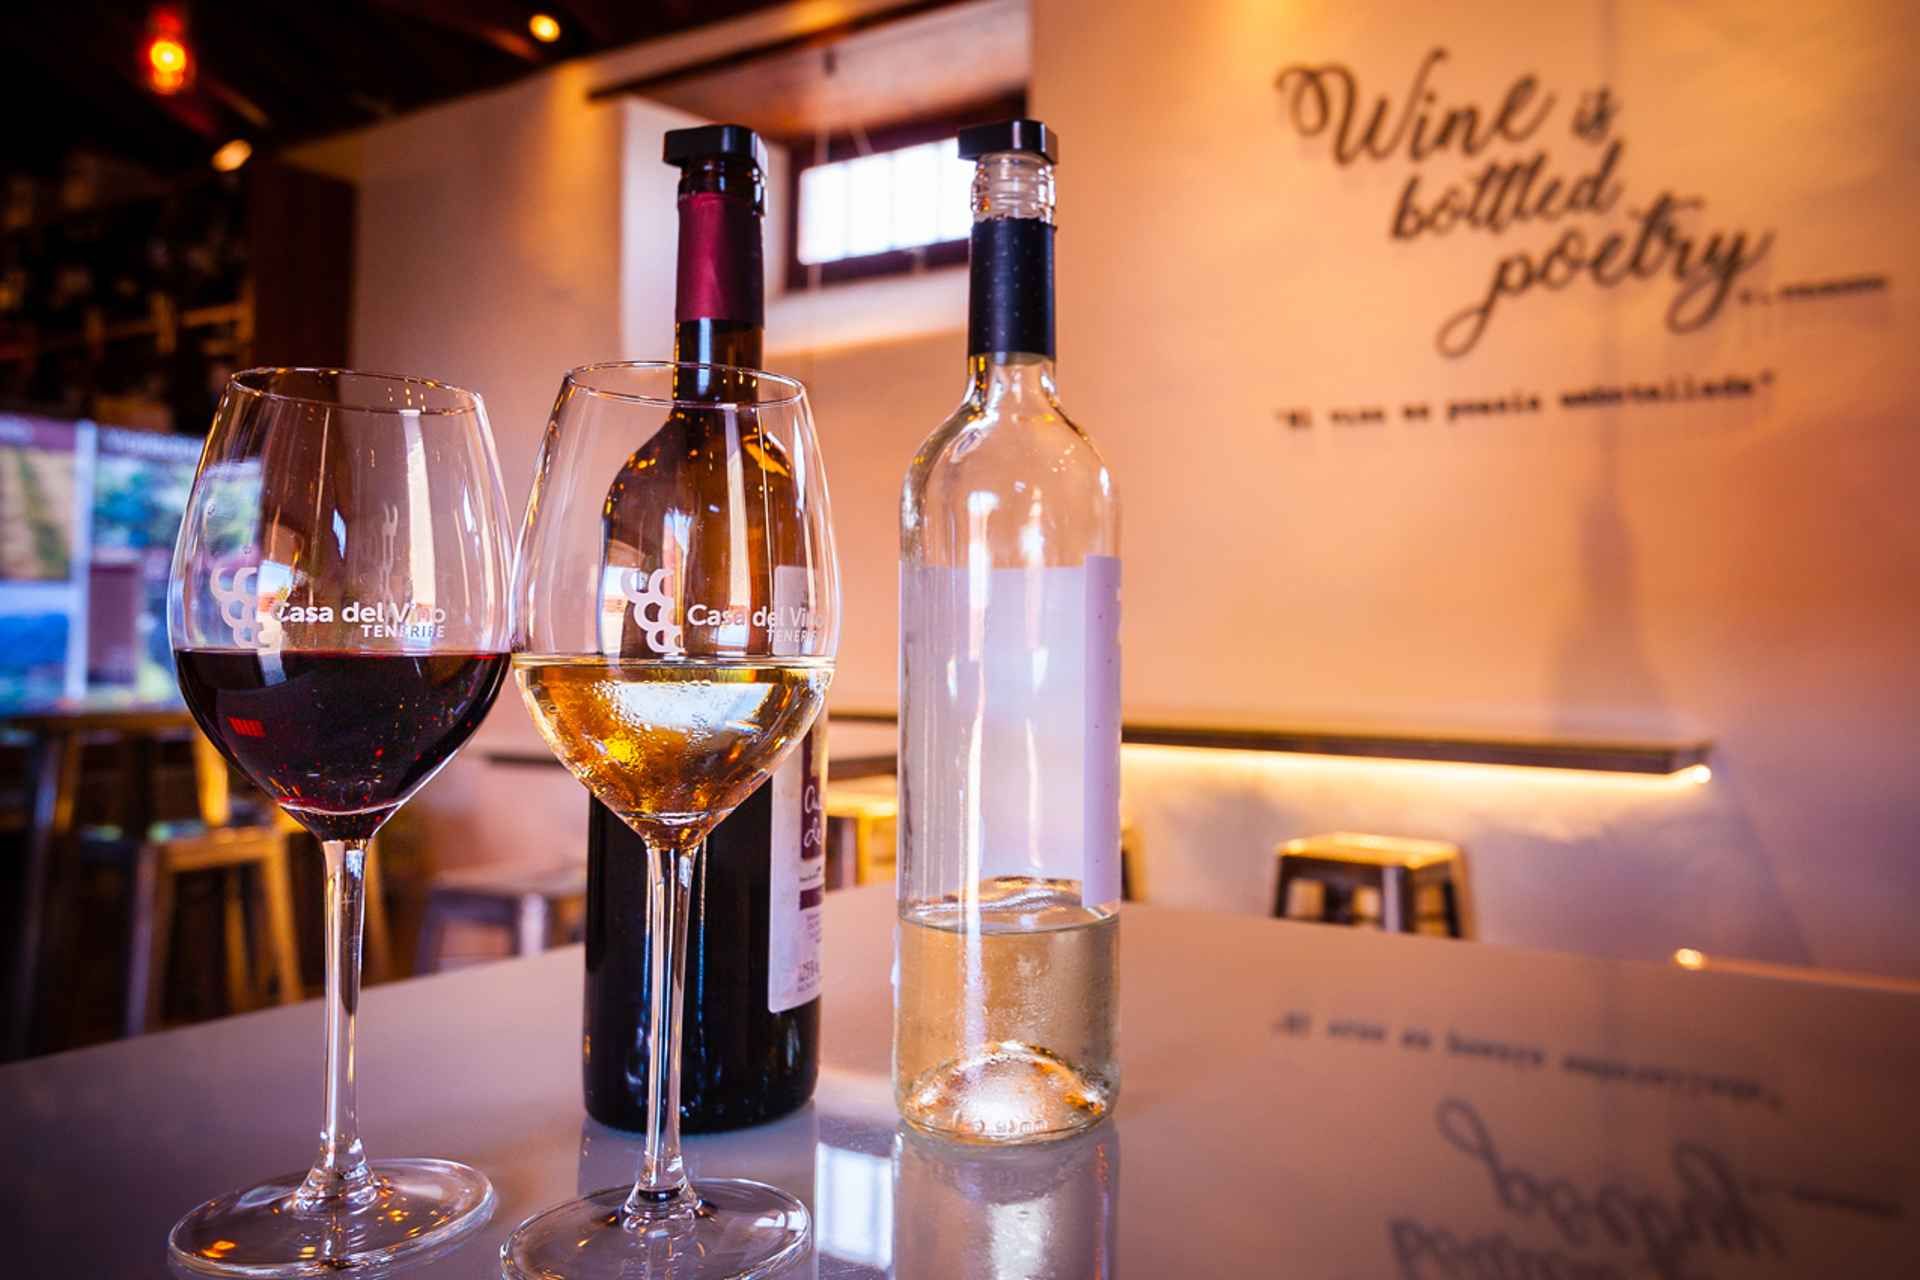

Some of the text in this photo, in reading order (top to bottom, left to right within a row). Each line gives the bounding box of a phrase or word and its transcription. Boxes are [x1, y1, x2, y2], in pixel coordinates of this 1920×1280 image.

[1275, 46, 1620, 165] Wine is
[1391, 139, 1625, 240] bottled
[1435, 190, 1777, 358] poetry
[273, 601, 334, 623] Casa
[341, 600, 385, 623] del
[686, 603, 746, 626] Casa
[752, 605, 785, 628] del
[361, 624, 446, 638] TENERIFE
[766, 628, 821, 642] TENERF
